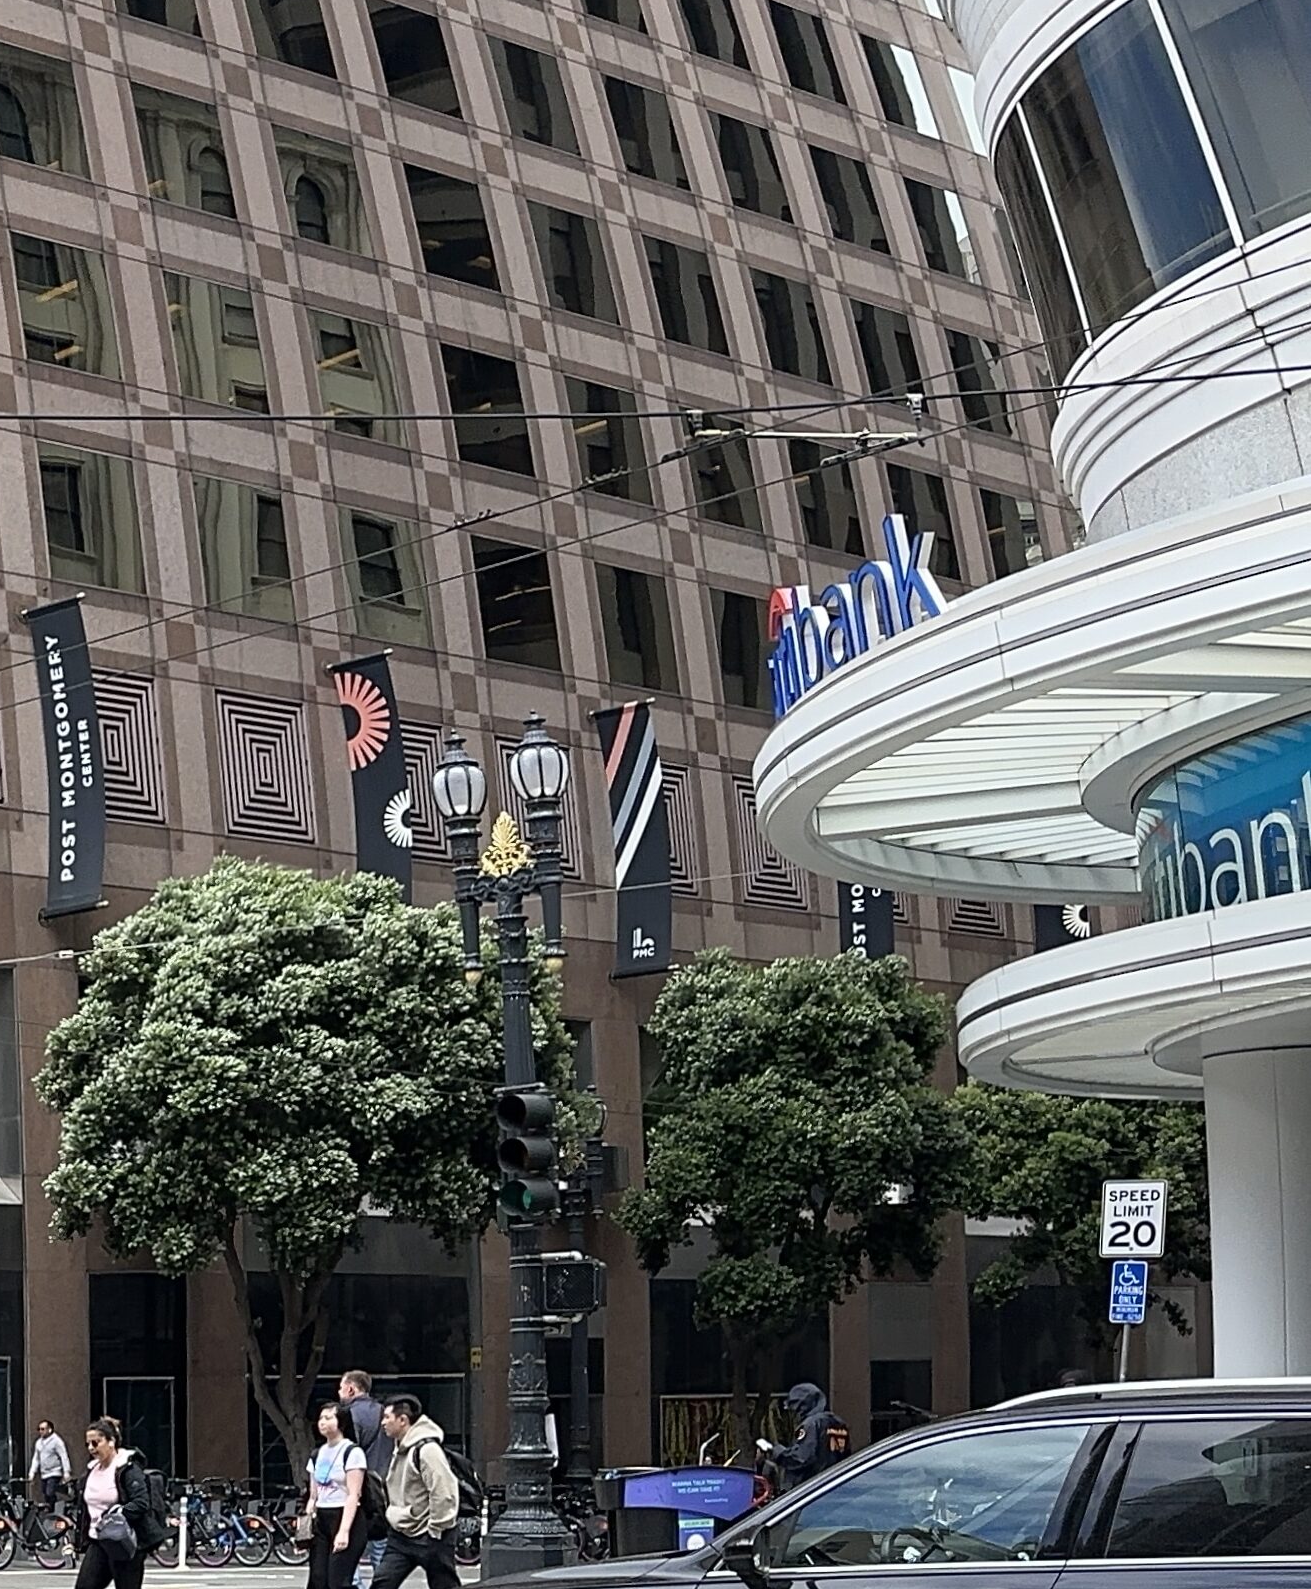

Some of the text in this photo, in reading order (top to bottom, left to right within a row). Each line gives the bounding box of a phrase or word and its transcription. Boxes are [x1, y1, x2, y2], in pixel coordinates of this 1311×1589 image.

[43, 634, 76, 883] POST MONTGOMERY
[77, 718, 94, 788] CENTER
[851, 921, 867, 961] OST
[632, 946, 655, 959] PMC
[1109, 1189, 1161, 1202] SPEED
[1113, 1205, 1154, 1218] LIMIT
[1108, 1220, 1156, 1248] 20
[1113, 1285, 1144, 1296] PARKING
[1119, 1295, 1138, 1304] ONLY
